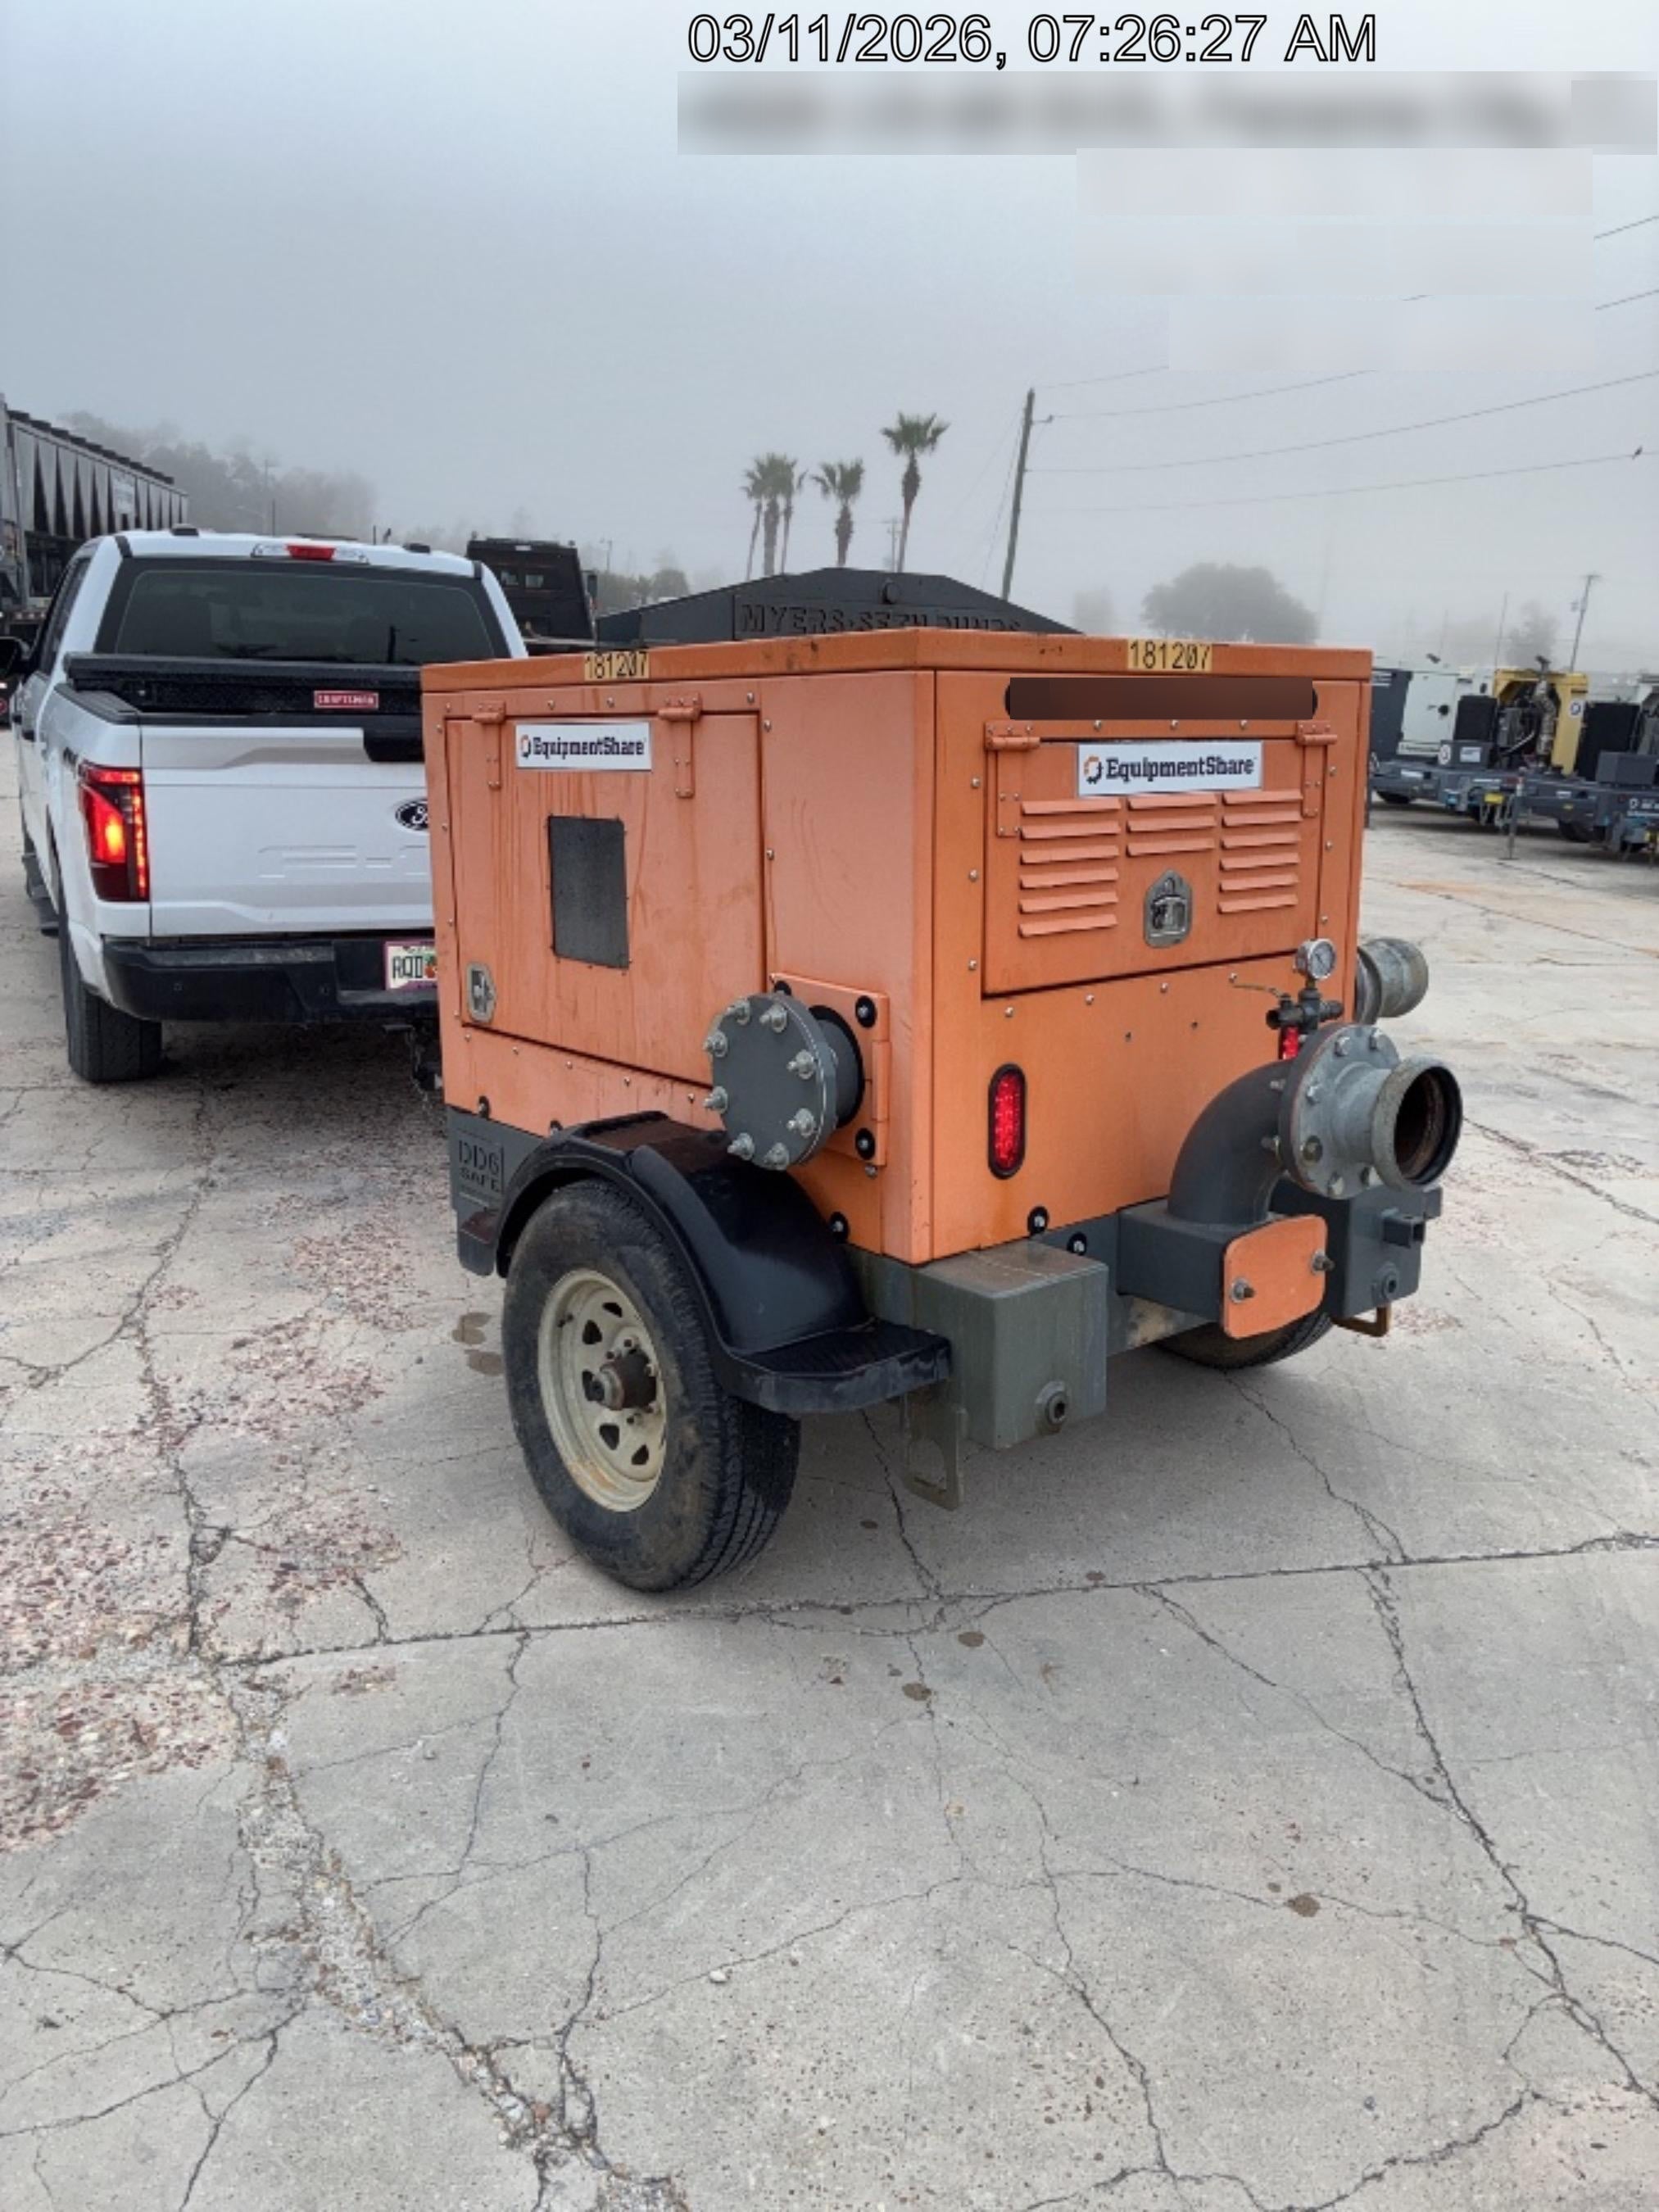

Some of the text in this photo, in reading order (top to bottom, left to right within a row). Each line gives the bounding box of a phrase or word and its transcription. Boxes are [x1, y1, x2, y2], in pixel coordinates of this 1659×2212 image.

[586, 651, 647, 679] 181207
[1130, 639, 1211, 669] 181207
[533, 737, 644, 760] EquipmentShare
[1105, 755, 1255, 784] EquipmentShare
